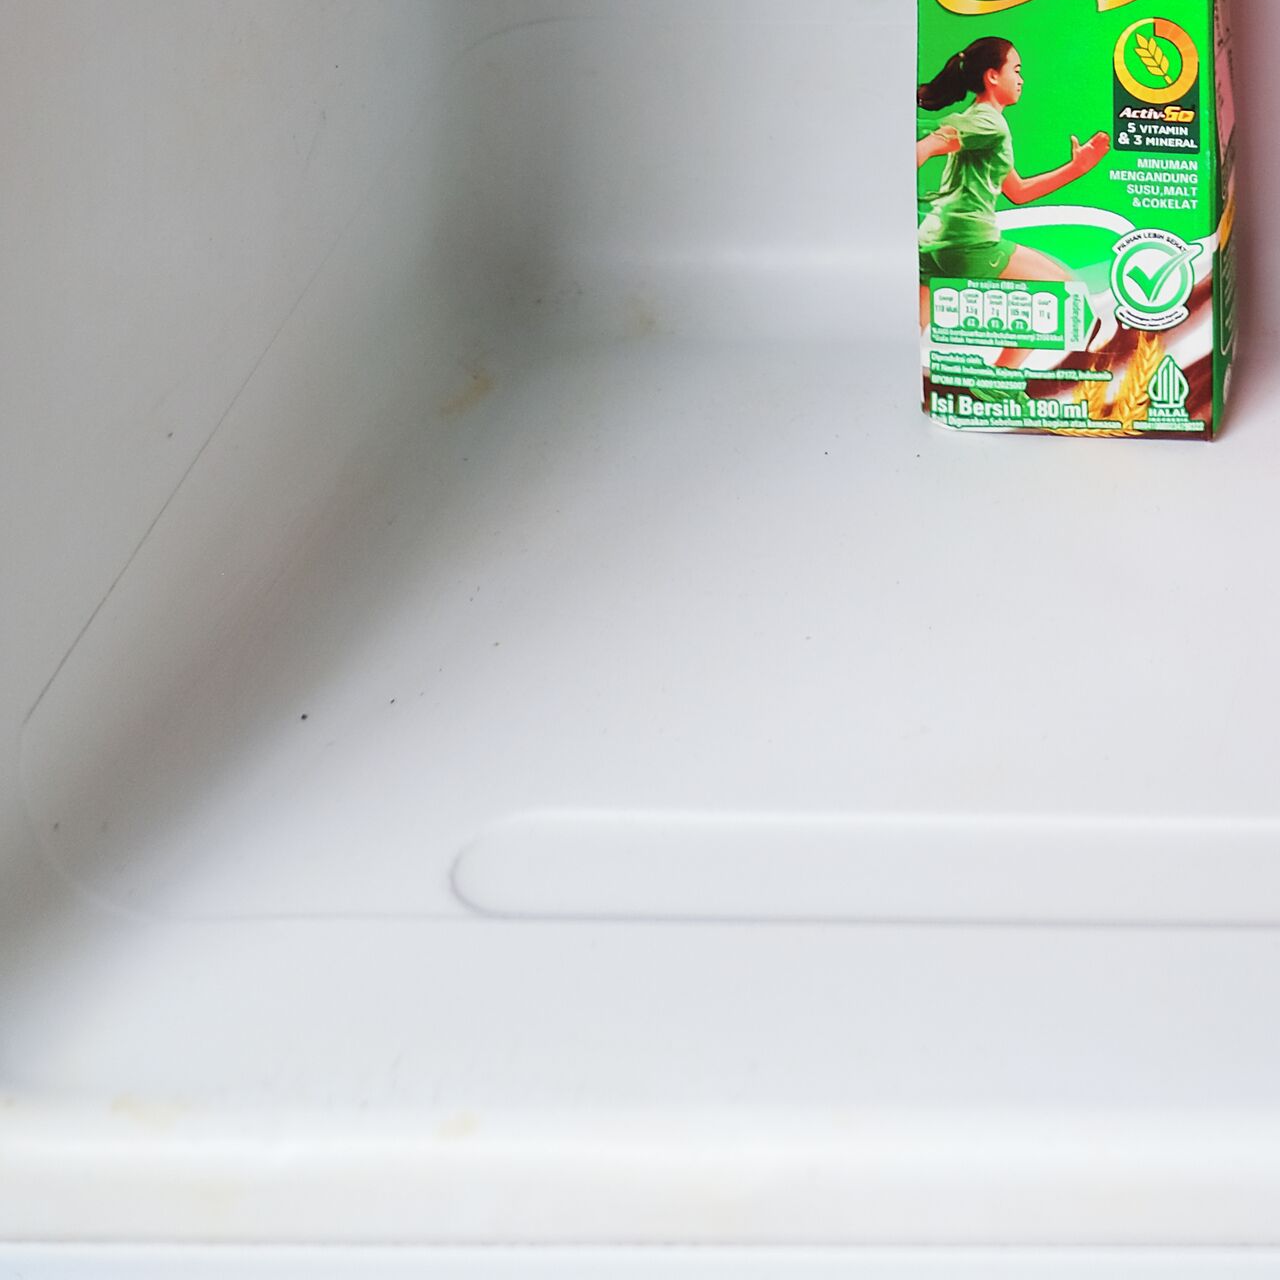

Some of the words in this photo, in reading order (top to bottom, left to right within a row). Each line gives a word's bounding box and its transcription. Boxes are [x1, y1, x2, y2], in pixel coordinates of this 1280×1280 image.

[1127, 123, 1136, 133] 5
[1140, 124, 1188, 135] VITAMIN
[1118, 132, 1130, 145] &
[1134, 135, 1142, 145] 3
[1146, 137, 1198, 148] MINERAL
[1137, 159, 1198, 171] MINUMAN
[1110, 170, 1198, 184] MENGANDUNG
[931, 392, 954, 413] Isi
[958, 395, 1021, 416] Bersih
[1027, 400, 1059, 418] 180
[1064, 400, 1087, 418] ml
[1149, 407, 1188, 417] HALAL
